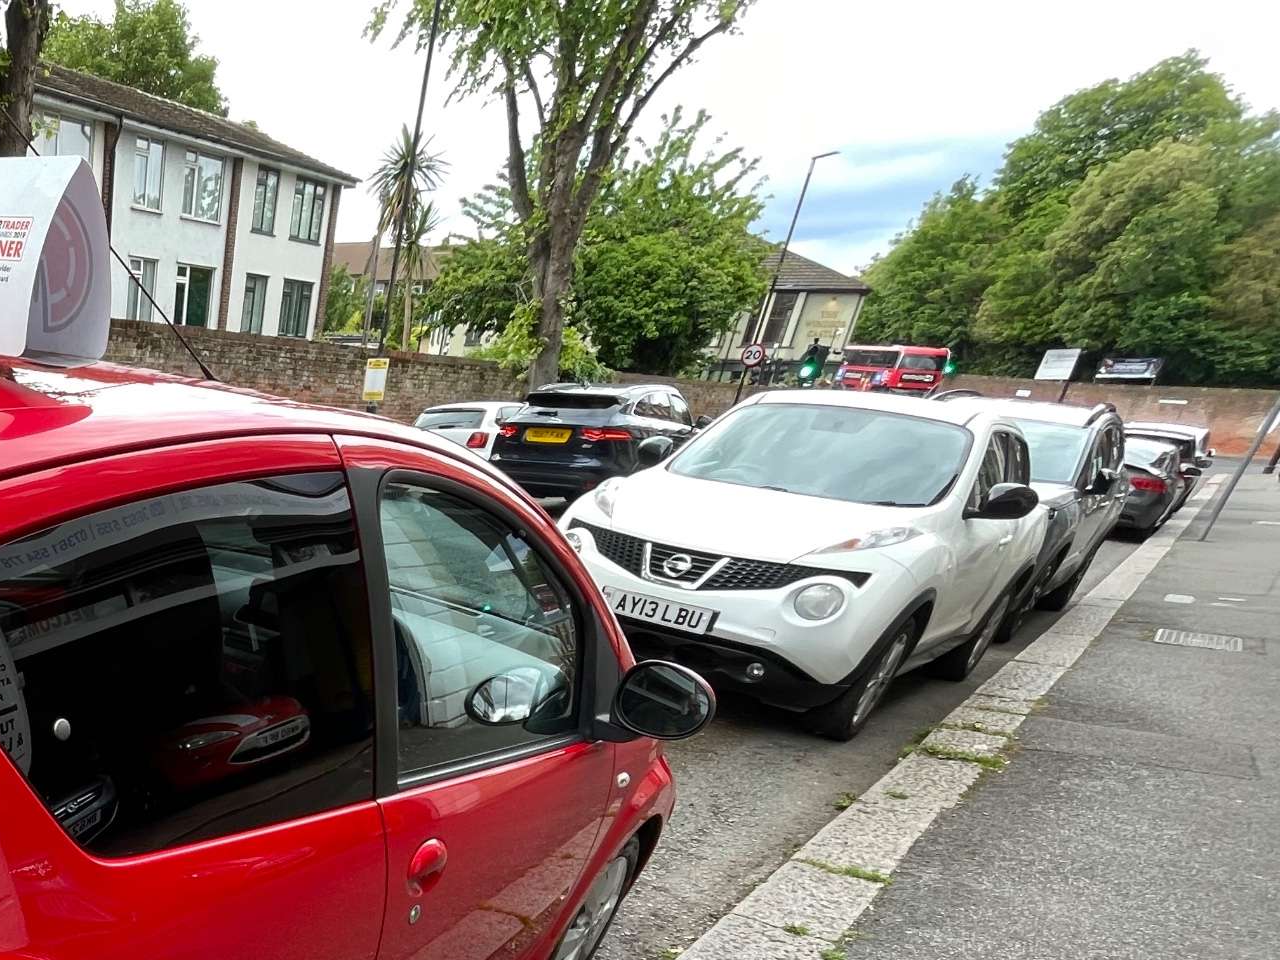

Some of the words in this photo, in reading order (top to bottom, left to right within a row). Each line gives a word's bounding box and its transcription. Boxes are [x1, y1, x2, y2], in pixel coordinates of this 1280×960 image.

[744, 350, 762, 360] 20
[616, 594, 659, 618] AY13
[661, 605, 704, 629] LBU
